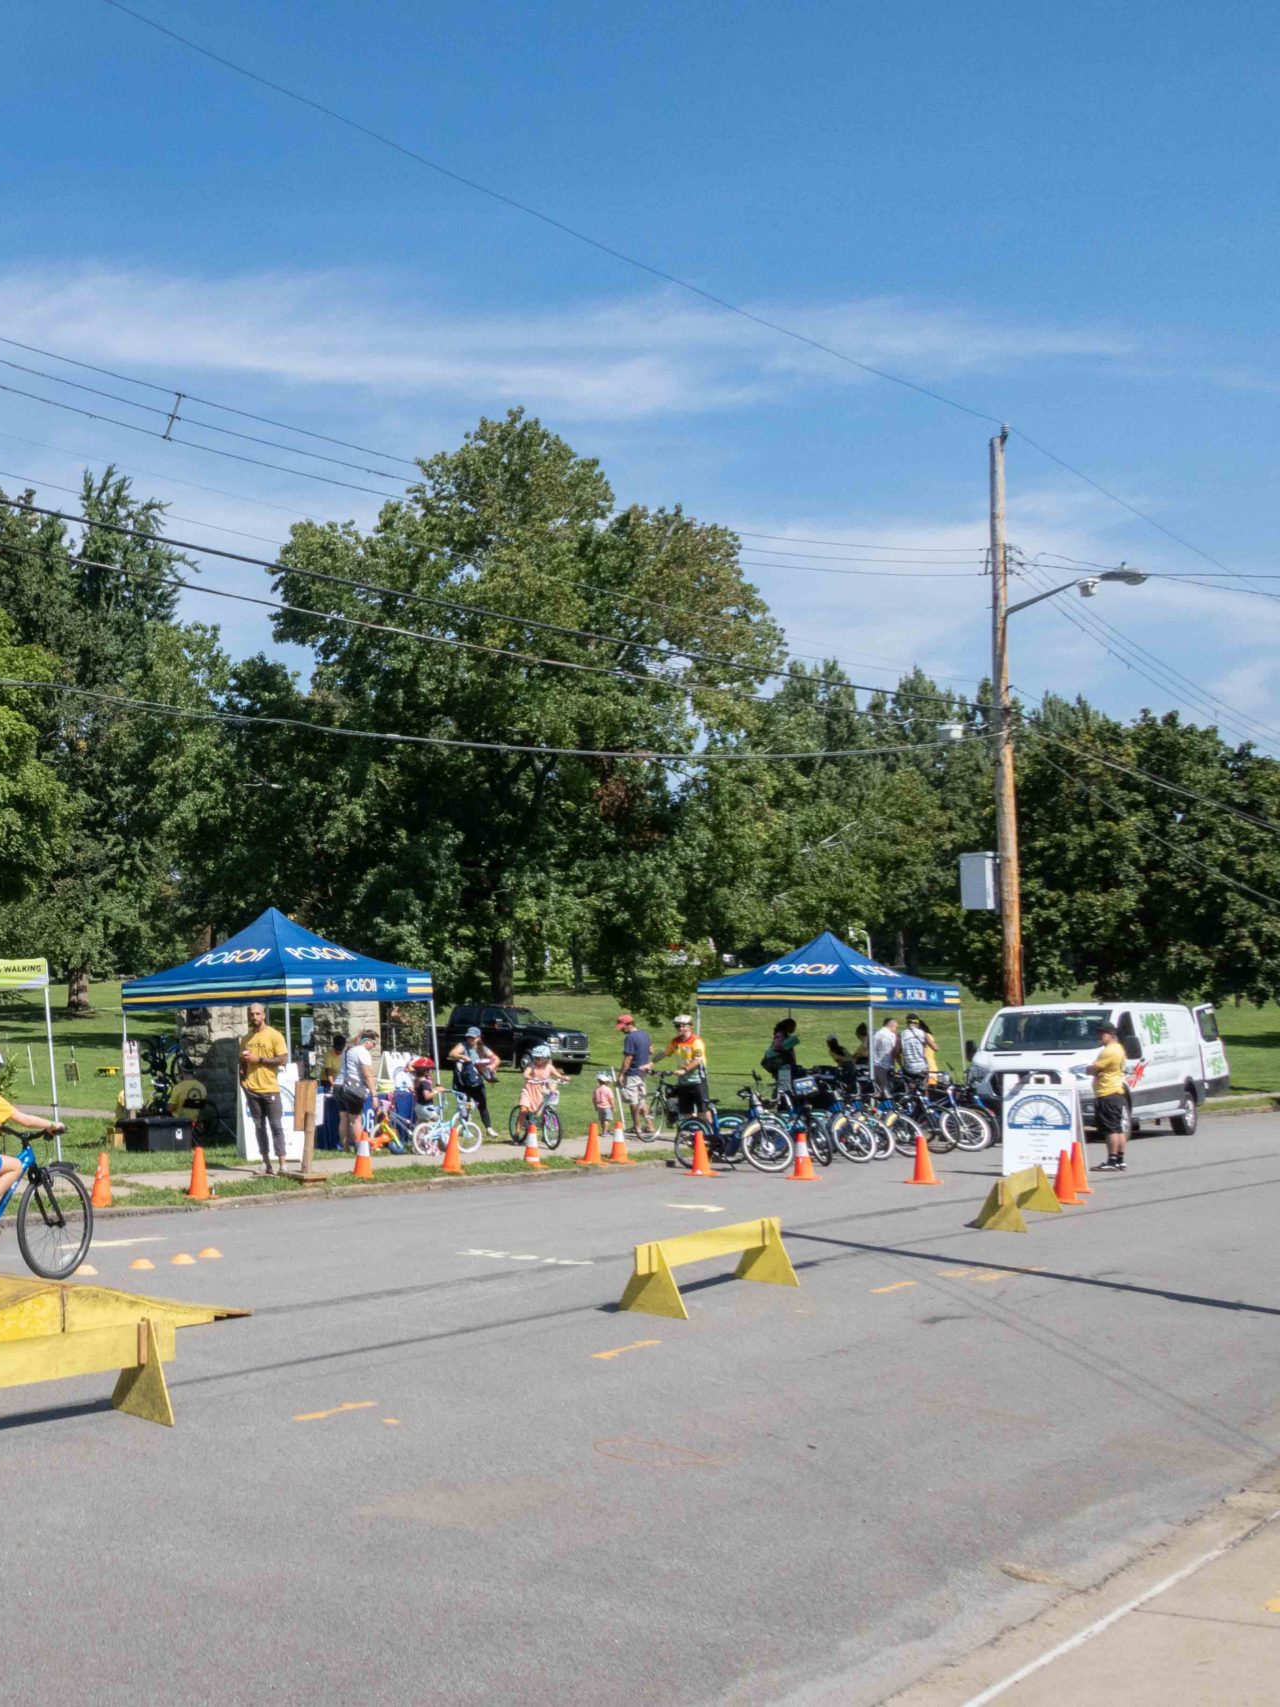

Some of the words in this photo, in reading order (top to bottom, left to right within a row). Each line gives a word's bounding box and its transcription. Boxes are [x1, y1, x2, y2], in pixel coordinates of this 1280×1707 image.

[194, 948, 271, 967] POGOH
[285, 947, 358, 961] POGOH
[3, 964, 42, 973] WALKING
[763, 963, 840, 975] POGOH
[345, 978, 378, 992] POGOH
